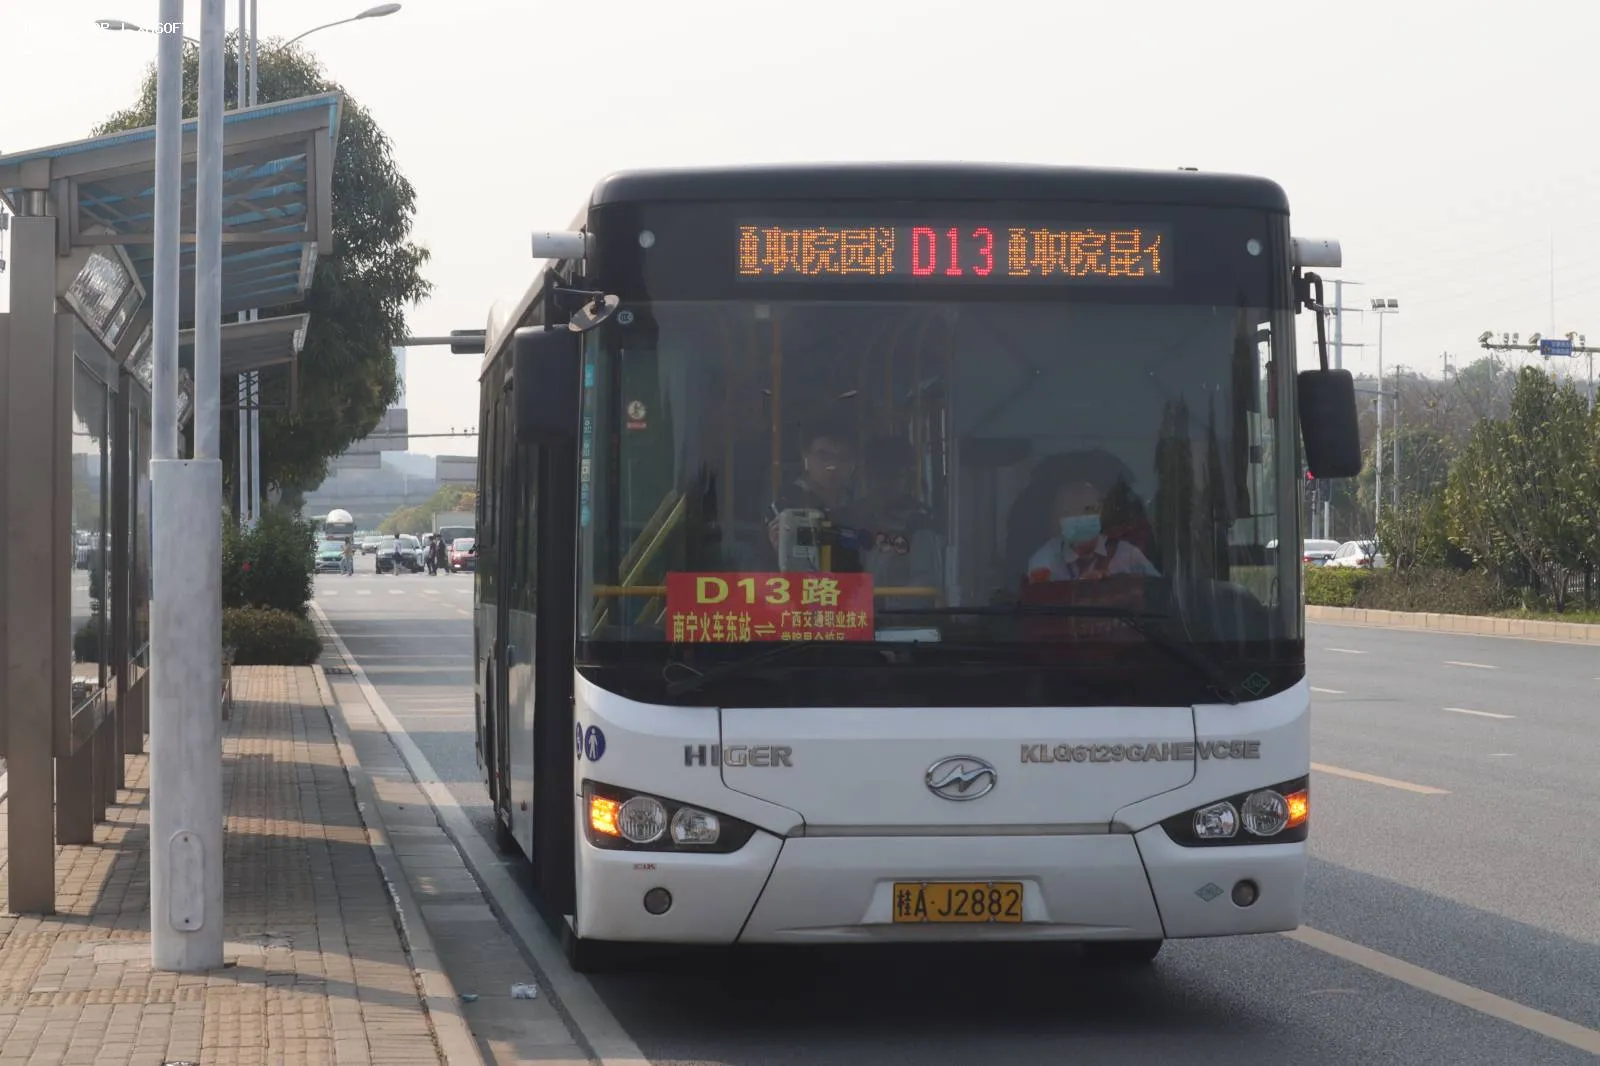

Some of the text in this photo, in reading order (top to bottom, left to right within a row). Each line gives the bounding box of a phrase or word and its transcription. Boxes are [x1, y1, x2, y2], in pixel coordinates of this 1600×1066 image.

[912, 226, 994, 276] D13
[673, 611, 752, 642] 南宁火车东站
[781, 610, 868, 628] 广西交通职业技术
[684, 744, 794, 767] HIGER
